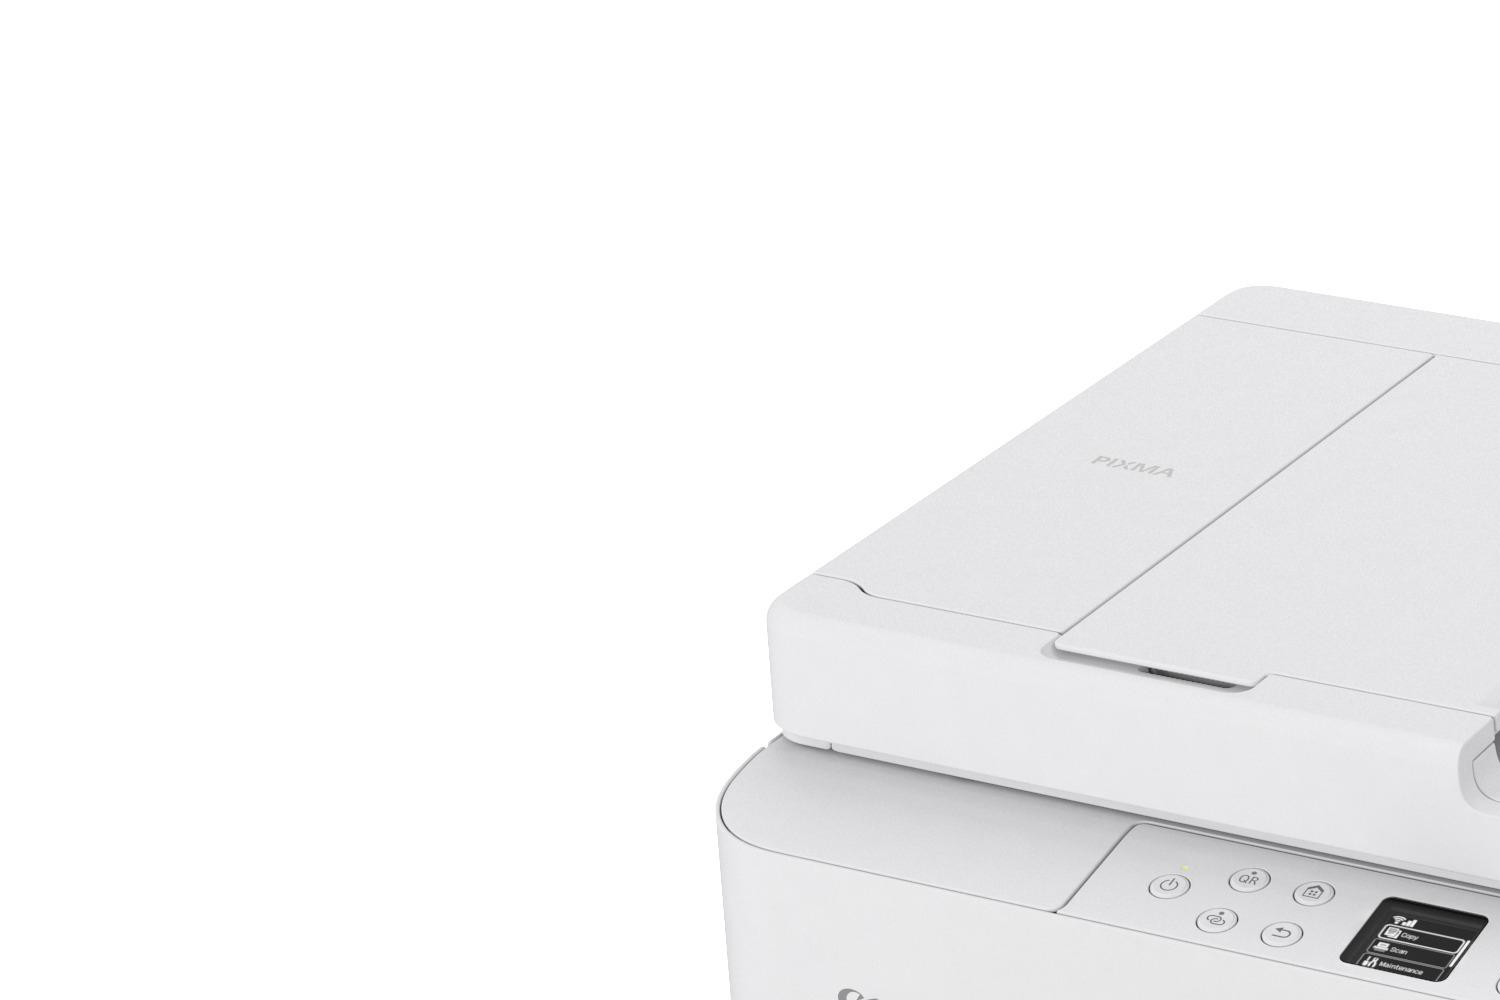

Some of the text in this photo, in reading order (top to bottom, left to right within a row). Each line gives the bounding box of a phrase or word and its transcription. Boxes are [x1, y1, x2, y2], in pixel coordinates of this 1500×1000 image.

[1091, 455, 1175, 478] PIXMA
[1239, 874, 1259, 886] QR
[1400, 931, 1420, 941] Copy
[1389, 946, 1409, 956] Scan
[1379, 960, 1424, 976] Maintenance
